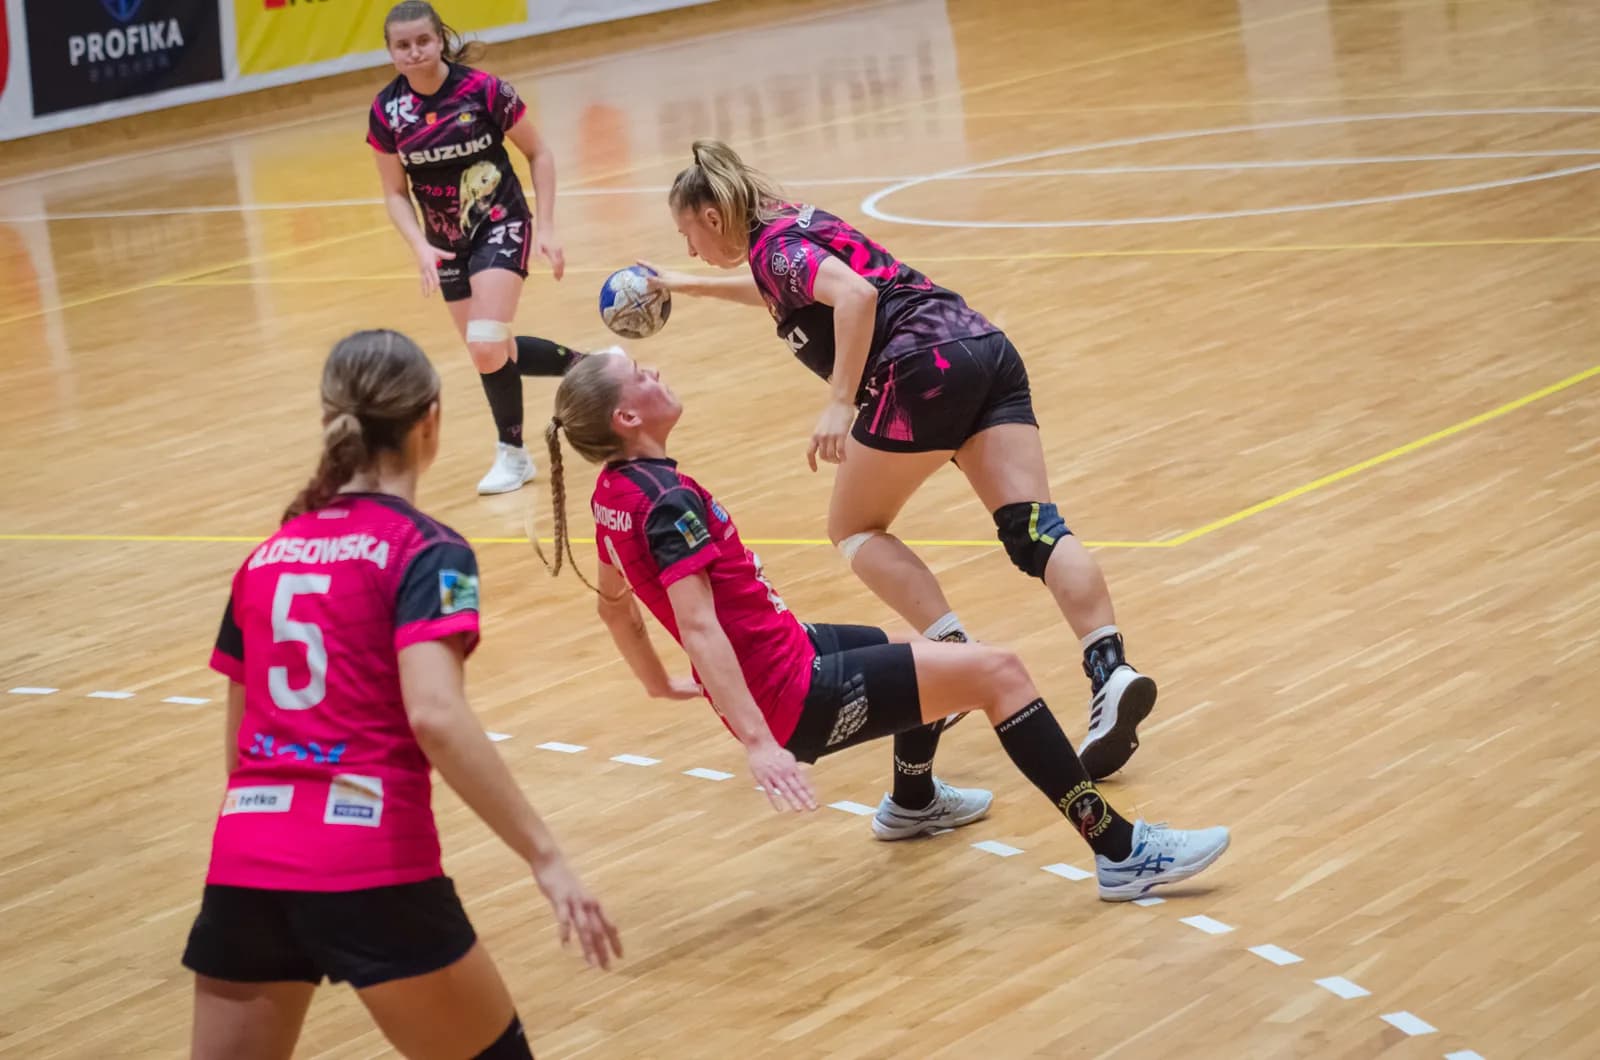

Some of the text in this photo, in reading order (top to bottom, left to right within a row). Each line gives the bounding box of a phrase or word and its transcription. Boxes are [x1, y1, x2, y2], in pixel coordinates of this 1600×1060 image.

[68, 18, 184, 66] PROFIKA
[409, 133, 493, 165] SUZUKI
[268, 573, 332, 710] 5
[1000, 702, 1044, 732] HANDBALL
[1088, 814, 1112, 839] TCZEW
